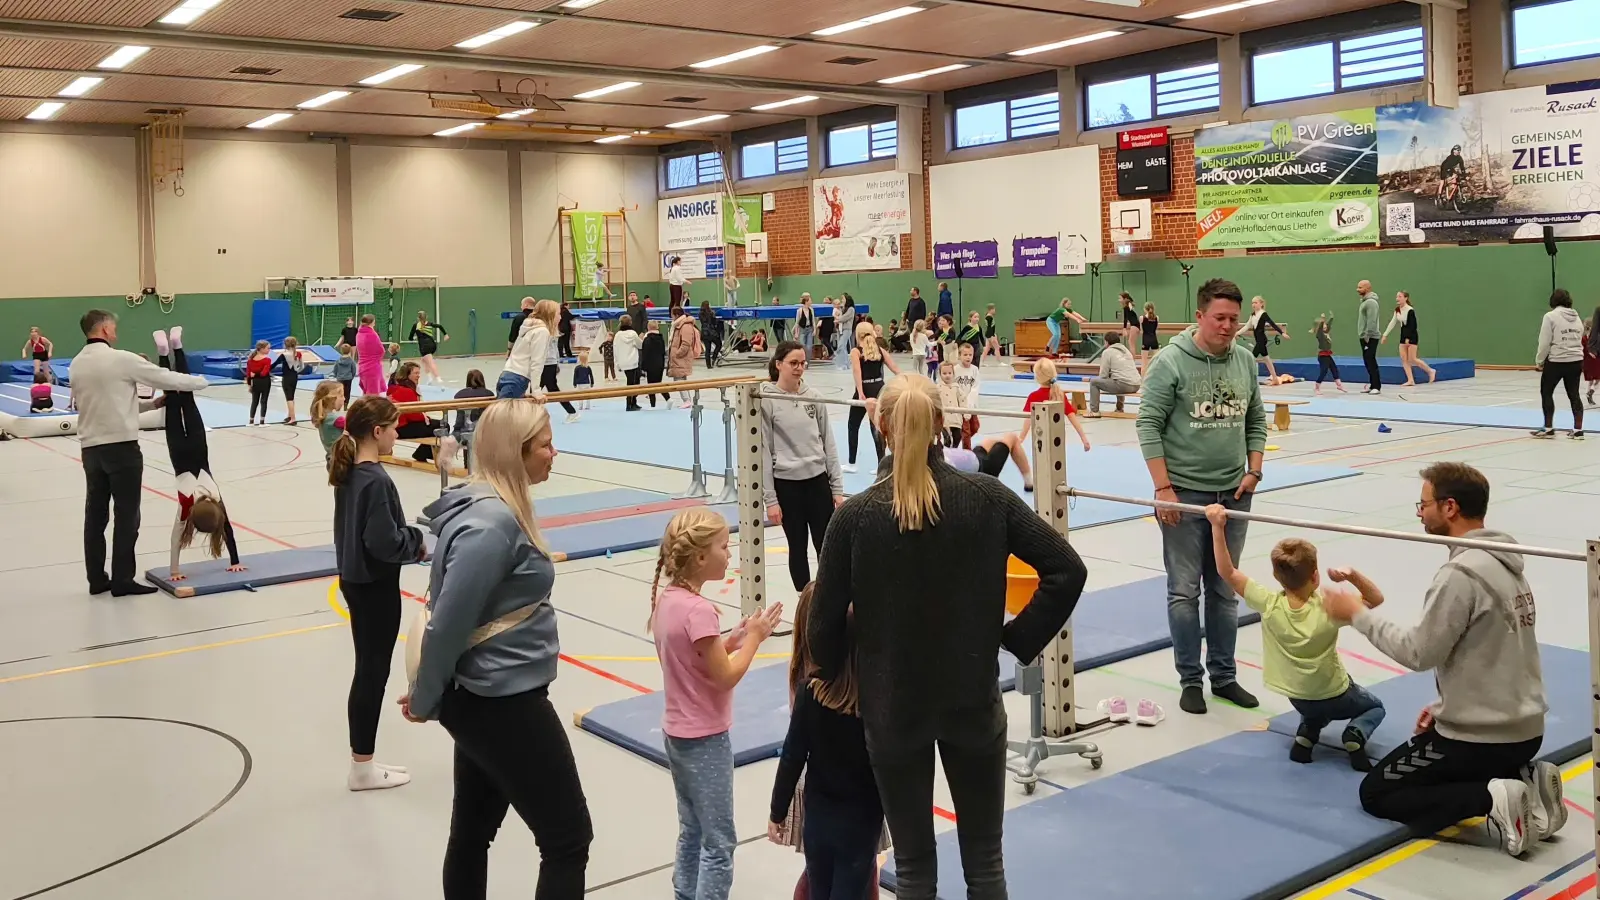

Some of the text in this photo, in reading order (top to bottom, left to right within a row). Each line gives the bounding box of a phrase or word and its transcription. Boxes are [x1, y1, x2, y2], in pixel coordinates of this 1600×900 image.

[1547, 97, 1597, 113] Rusack
[1130, 132, 1164, 141] Stadtsparkasse
[1297, 121, 1374, 141] PV Green
[1511, 129, 1582, 144] GEMEINSAM
[1131, 139, 1152, 147] Wunstorf
[1201, 151, 1296, 169] DEINE INDIVIDUELLE
[1512, 143, 1583, 170] ZIELE
[1201, 162, 1327, 183] PHOTOVOLTAIKANLAGE
[1512, 170, 1584, 185] ERREICHEN
[879, 179, 899, 188] Energie
[1329, 187, 1372, 200] pvgreen.de
[667, 200, 718, 220] ANSORGE
[1235, 212, 1256, 221] online
[1270, 210, 1284, 219] Ort
[1285, 208, 1324, 219] einkaufen
[1199, 209, 1224, 232] NEU:
[1476, 218, 1508, 226] FAHRRAD!
[1514, 215, 1582, 224] fahrradhaus-rusack.de
[940, 251, 950, 260] Was
[1020, 243, 1051, 258] Trampolin-
[978, 257, 996, 267] runter!
[1026, 258, 1046, 267] turnen
